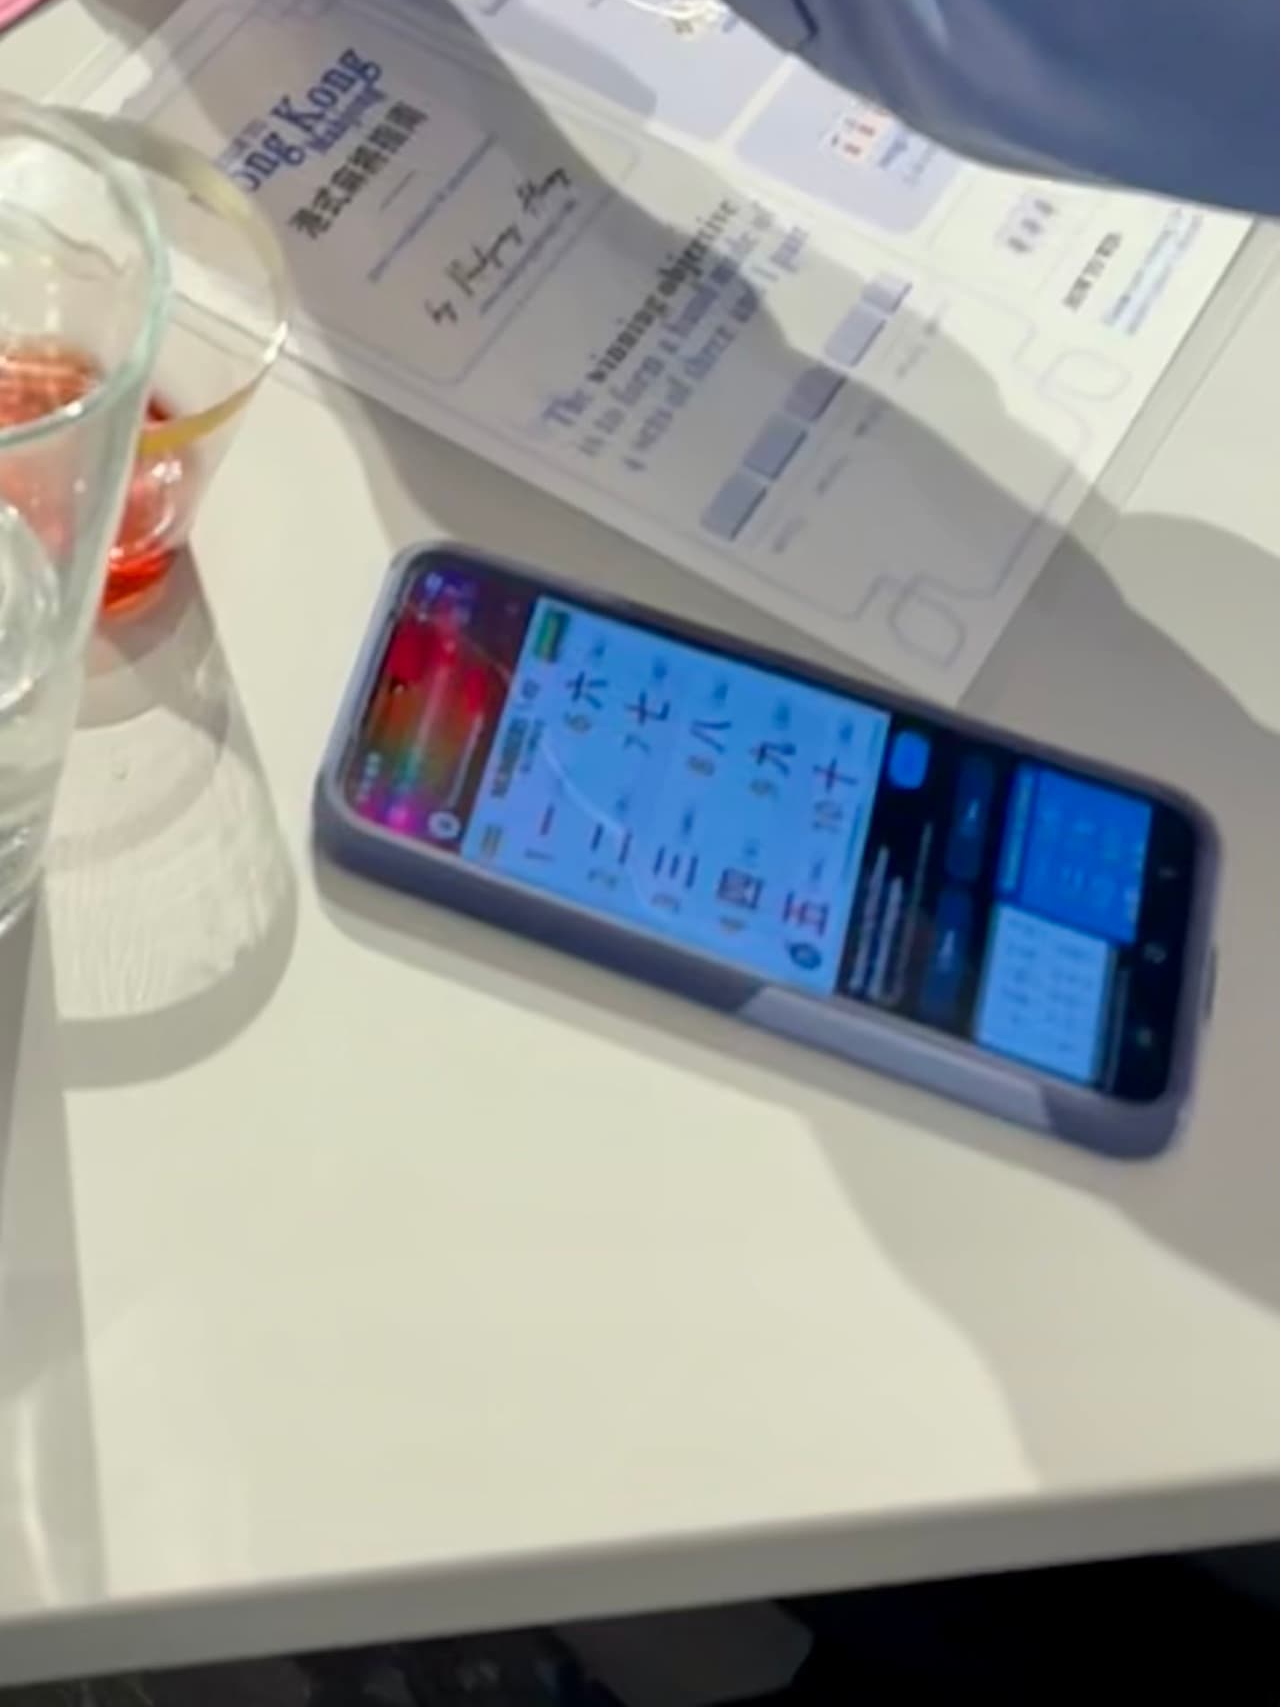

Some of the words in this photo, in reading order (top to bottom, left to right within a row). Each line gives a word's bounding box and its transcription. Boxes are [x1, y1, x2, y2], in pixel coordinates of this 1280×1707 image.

[270, 47, 383, 135] Kong
[565, 671, 608, 710] 六
[625, 691, 671, 726] 七
[689, 719, 733, 755] 八
[749, 739, 798, 777] 九
[812, 757, 859, 794] 十
[652, 845, 700, 889] 三
[715, 866, 766, 912] 四
[781, 890, 830, 937] 五
